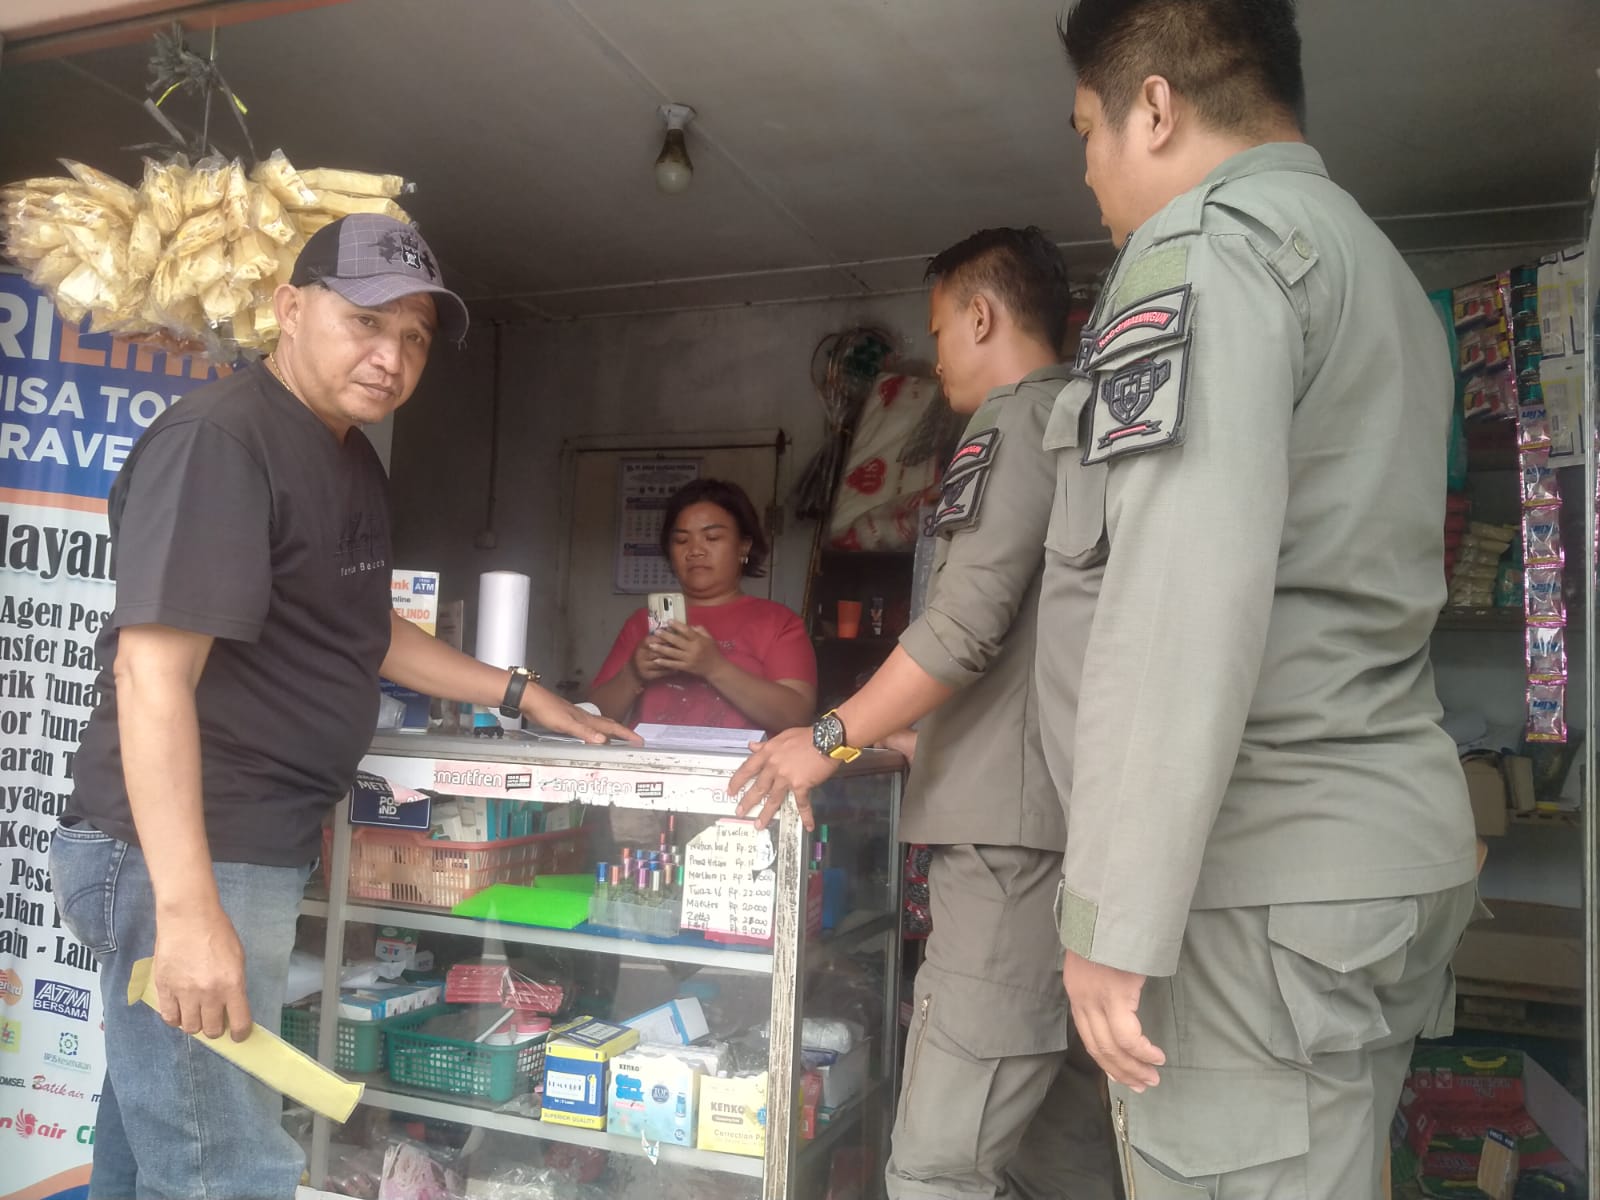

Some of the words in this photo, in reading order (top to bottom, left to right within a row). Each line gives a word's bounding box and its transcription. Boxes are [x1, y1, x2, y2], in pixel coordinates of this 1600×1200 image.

[0, 375, 85, 422] ISA
[99, 385, 183, 428] TO
[415, 582, 435, 592] ATM
[0, 596, 62, 630] Agen
[0, 710, 32, 735] or
[0, 747, 53, 777] aran
[36, 982, 91, 1011] ATM
[34, 1000, 89, 1021] BERSAMA
[32, 1074, 68, 1096] Batik
[711, 1101, 745, 1115] KENKO
[37, 1122, 67, 1140] air
